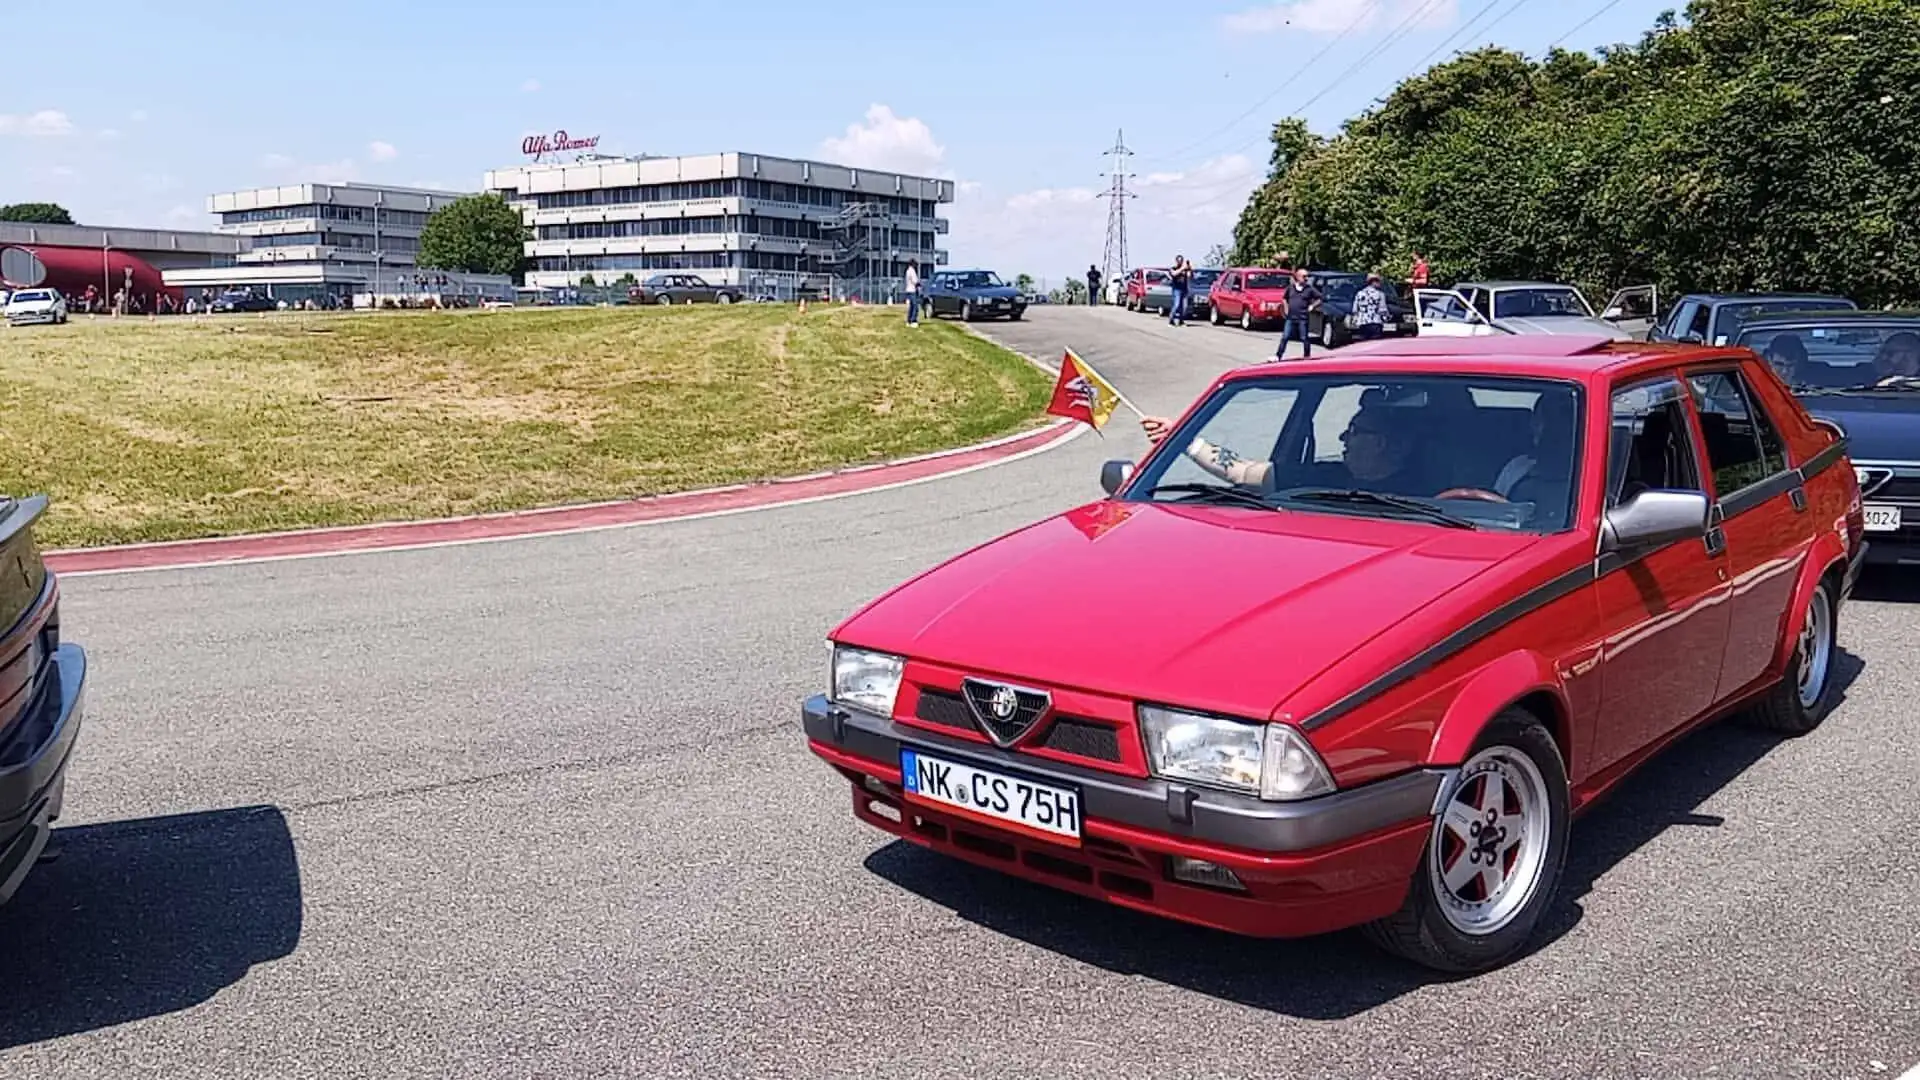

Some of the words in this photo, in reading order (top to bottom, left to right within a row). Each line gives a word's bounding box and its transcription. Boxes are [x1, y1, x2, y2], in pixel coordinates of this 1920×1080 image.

[522, 135, 551, 162] Alfa
[553, 129, 600, 151] Romeo
[918, 759, 952, 800] NK
[972, 773, 1009, 813] CS
[1016, 783, 1076, 831] 75H
